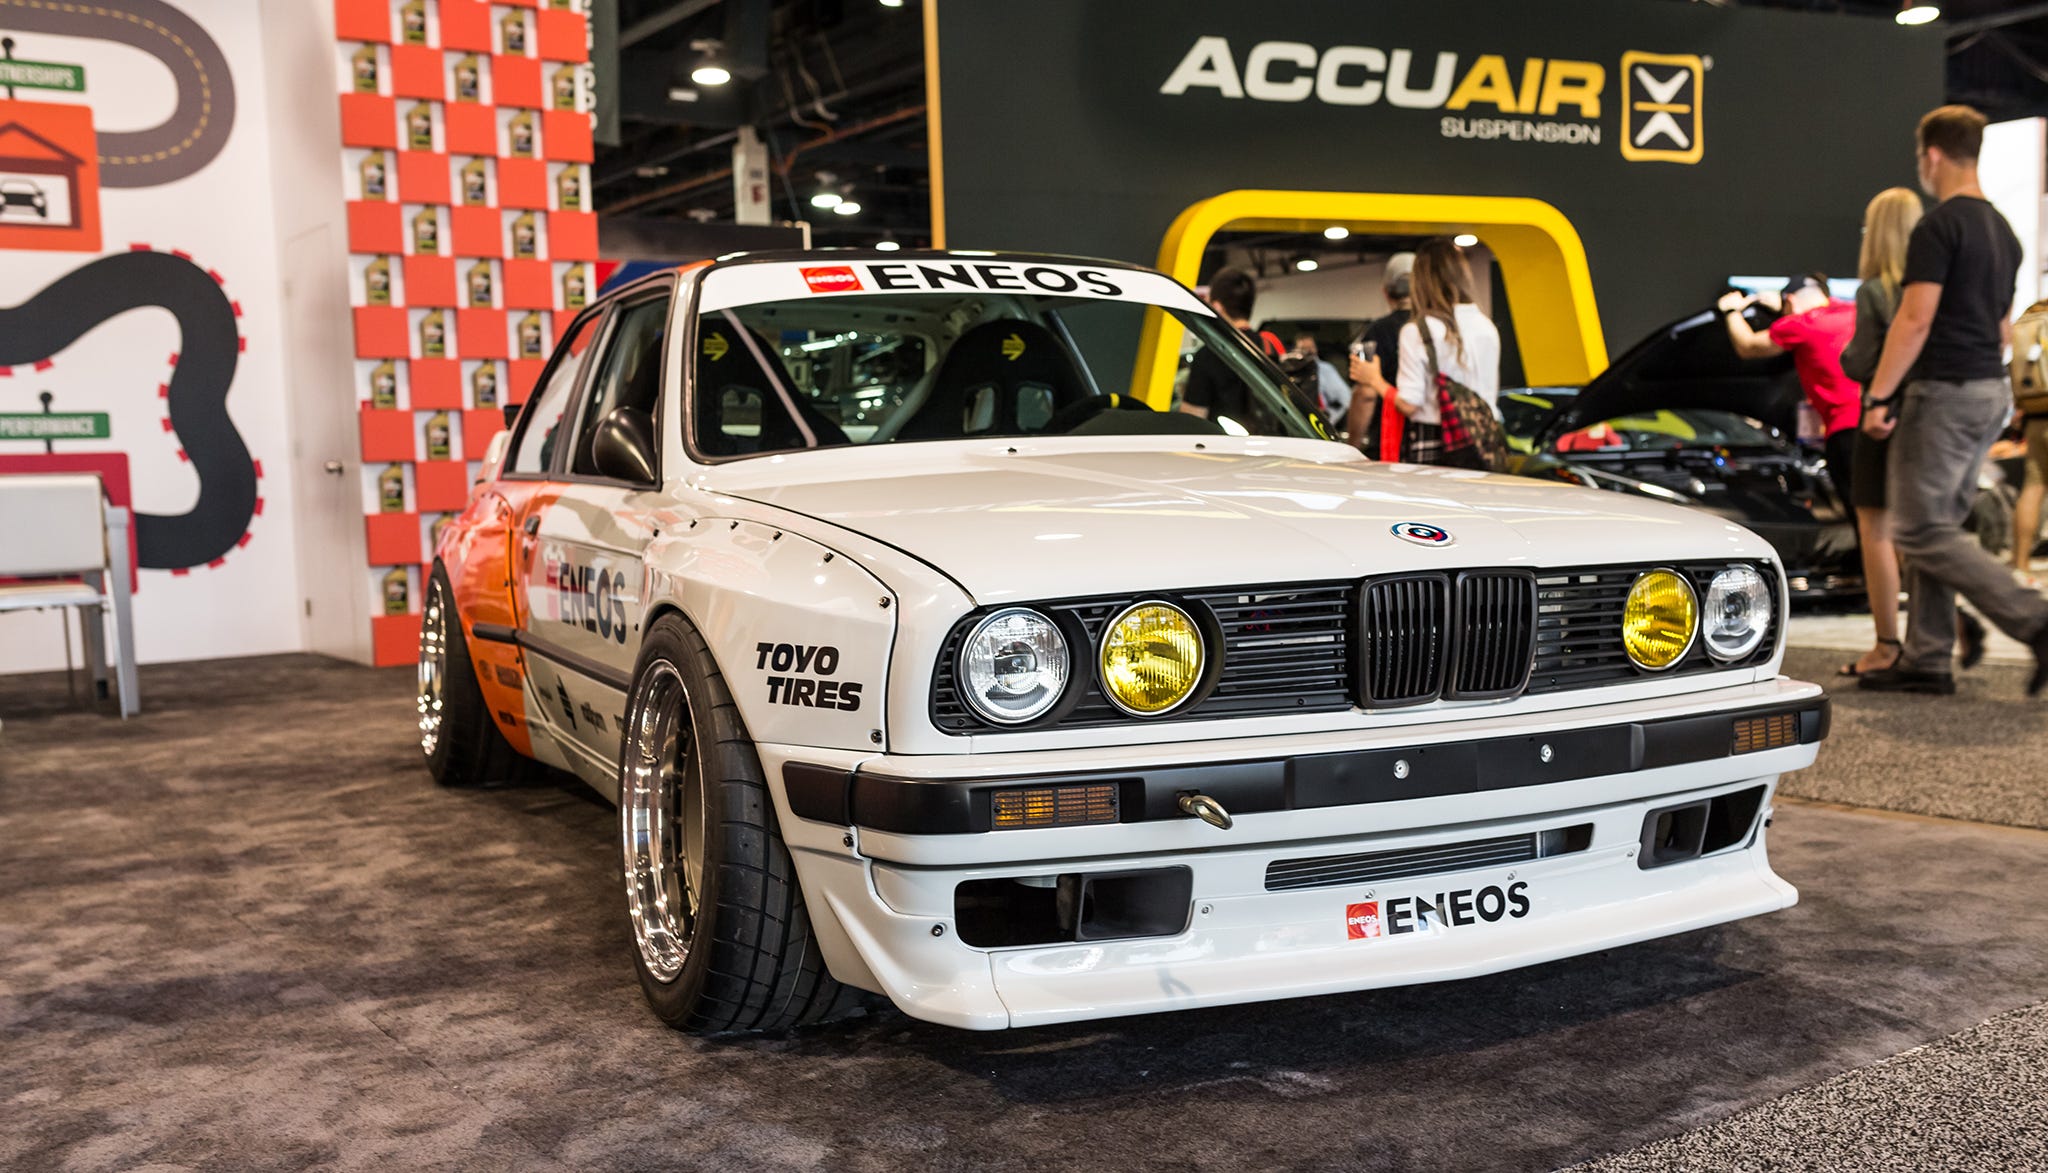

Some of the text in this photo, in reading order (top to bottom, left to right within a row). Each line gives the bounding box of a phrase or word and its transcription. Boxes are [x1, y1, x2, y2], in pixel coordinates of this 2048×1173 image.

[1160, 36, 1605, 118] ACCUAIR
[1441, 117, 1601, 144] SUSPENSION
[806, 274, 856, 284] ENEOS
[866, 264, 1123, 297] ENEOS
[560, 562, 626, 645] ENEOS
[756, 642, 840, 675] TOYO
[767, 676, 863, 711] TIRES
[1348, 914, 1378, 926] ENEOS
[1386, 881, 1530, 935] ENEOS
